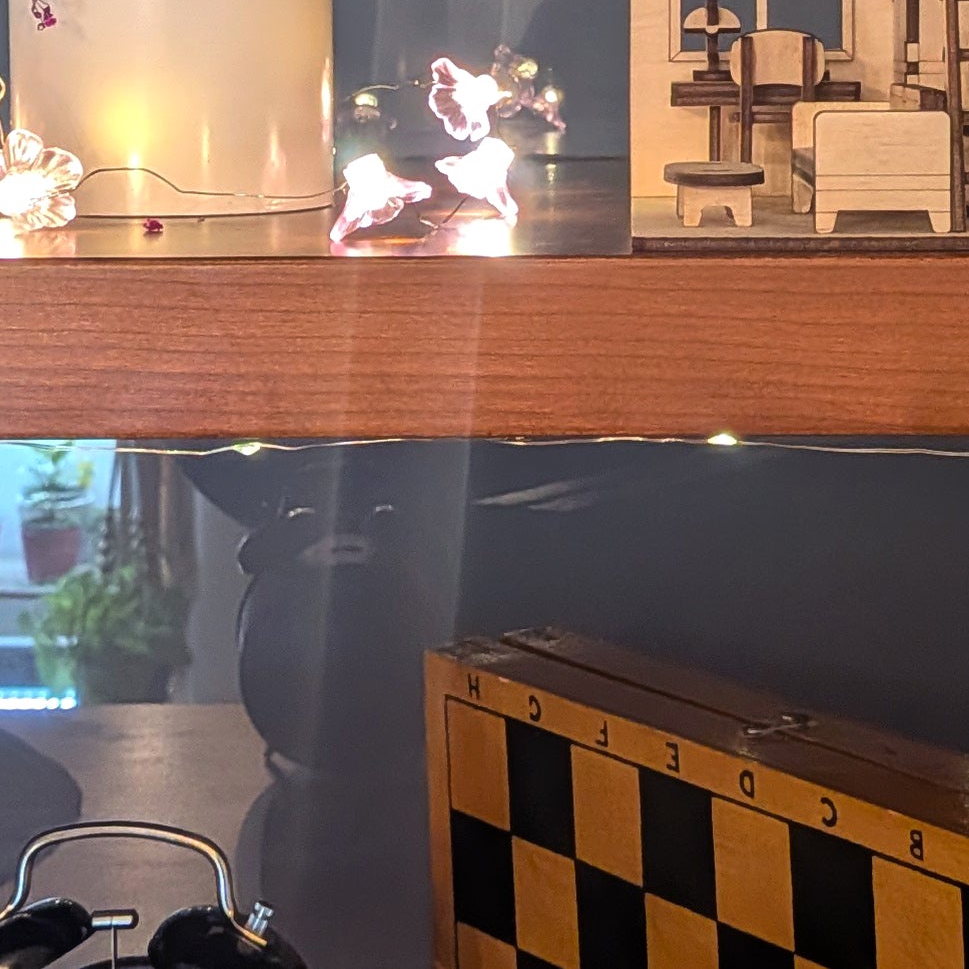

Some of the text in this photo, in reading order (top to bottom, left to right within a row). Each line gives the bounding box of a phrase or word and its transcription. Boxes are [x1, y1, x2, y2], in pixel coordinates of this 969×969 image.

[467, 673, 481, 701] H
[595, 720, 609, 748] F
[665, 741, 680, 773] E
[739, 769, 755, 799] D
[820, 797, 837, 827] C
[909, 829, 924, 861] B
